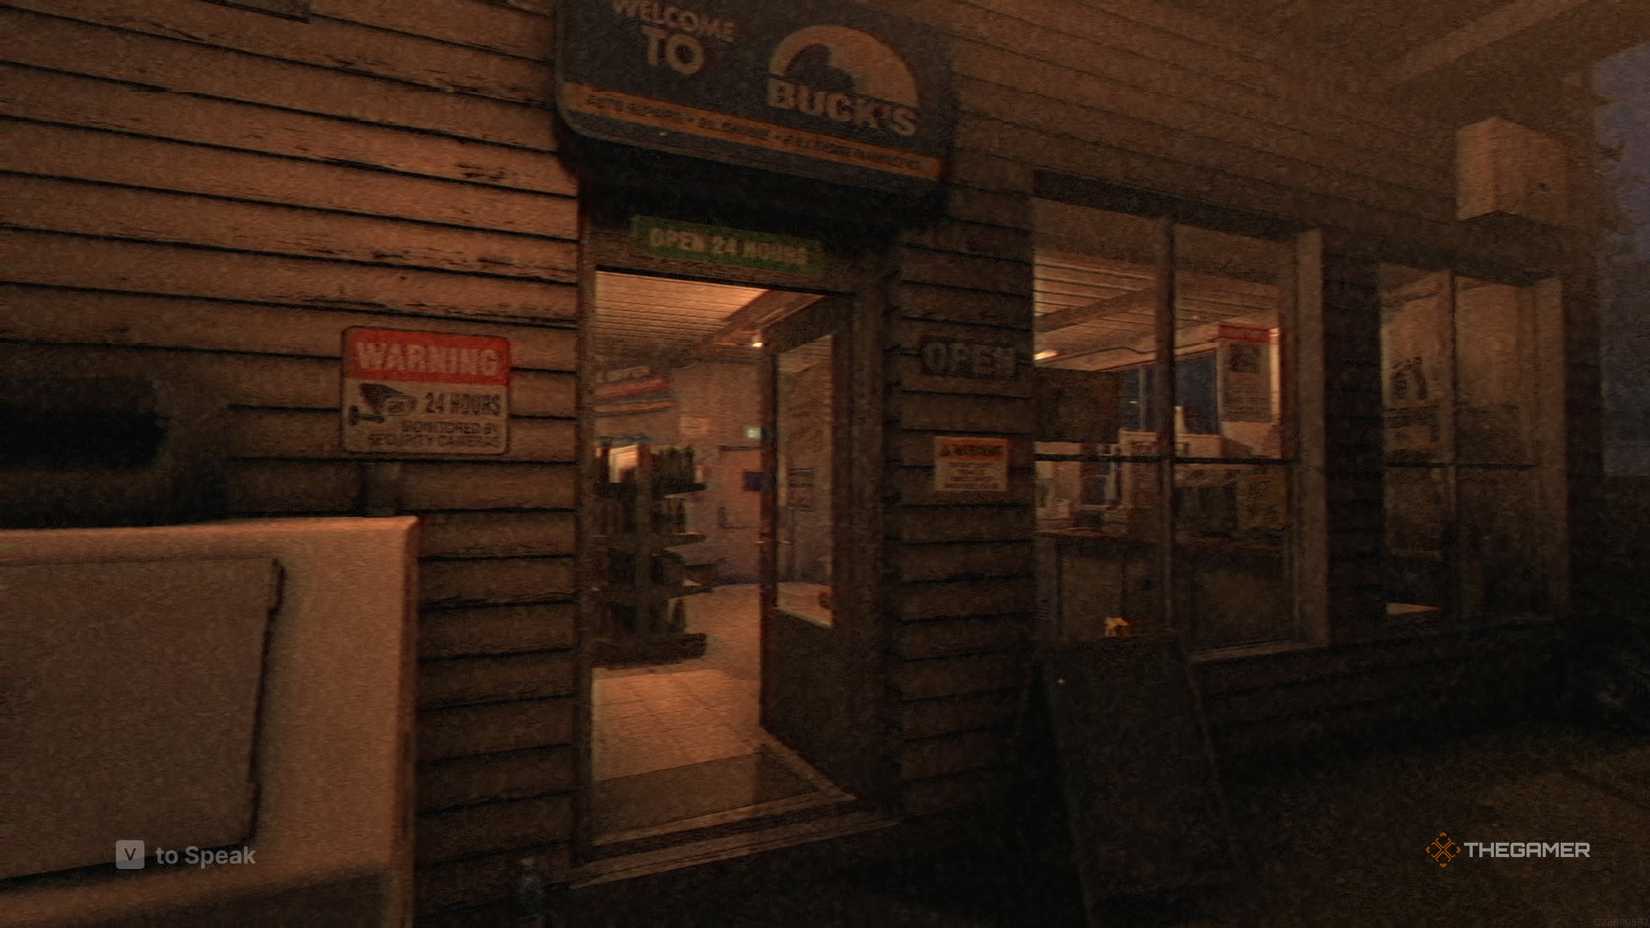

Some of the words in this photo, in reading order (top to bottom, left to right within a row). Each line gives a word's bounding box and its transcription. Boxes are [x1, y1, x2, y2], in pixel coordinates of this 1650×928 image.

[612, 0, 736, 43] WELCOME
[641, 24, 705, 76] TO
[766, 77, 918, 138] BUCK'S
[648, 226, 706, 253] OPEN
[711, 235, 739, 256] 24
[742, 240, 809, 266] HOURS
[356, 341, 499, 377] WARNING
[922, 342, 1015, 377] OPEN
[424, 391, 445, 414] 24
[449, 393, 502, 418] HOURS
